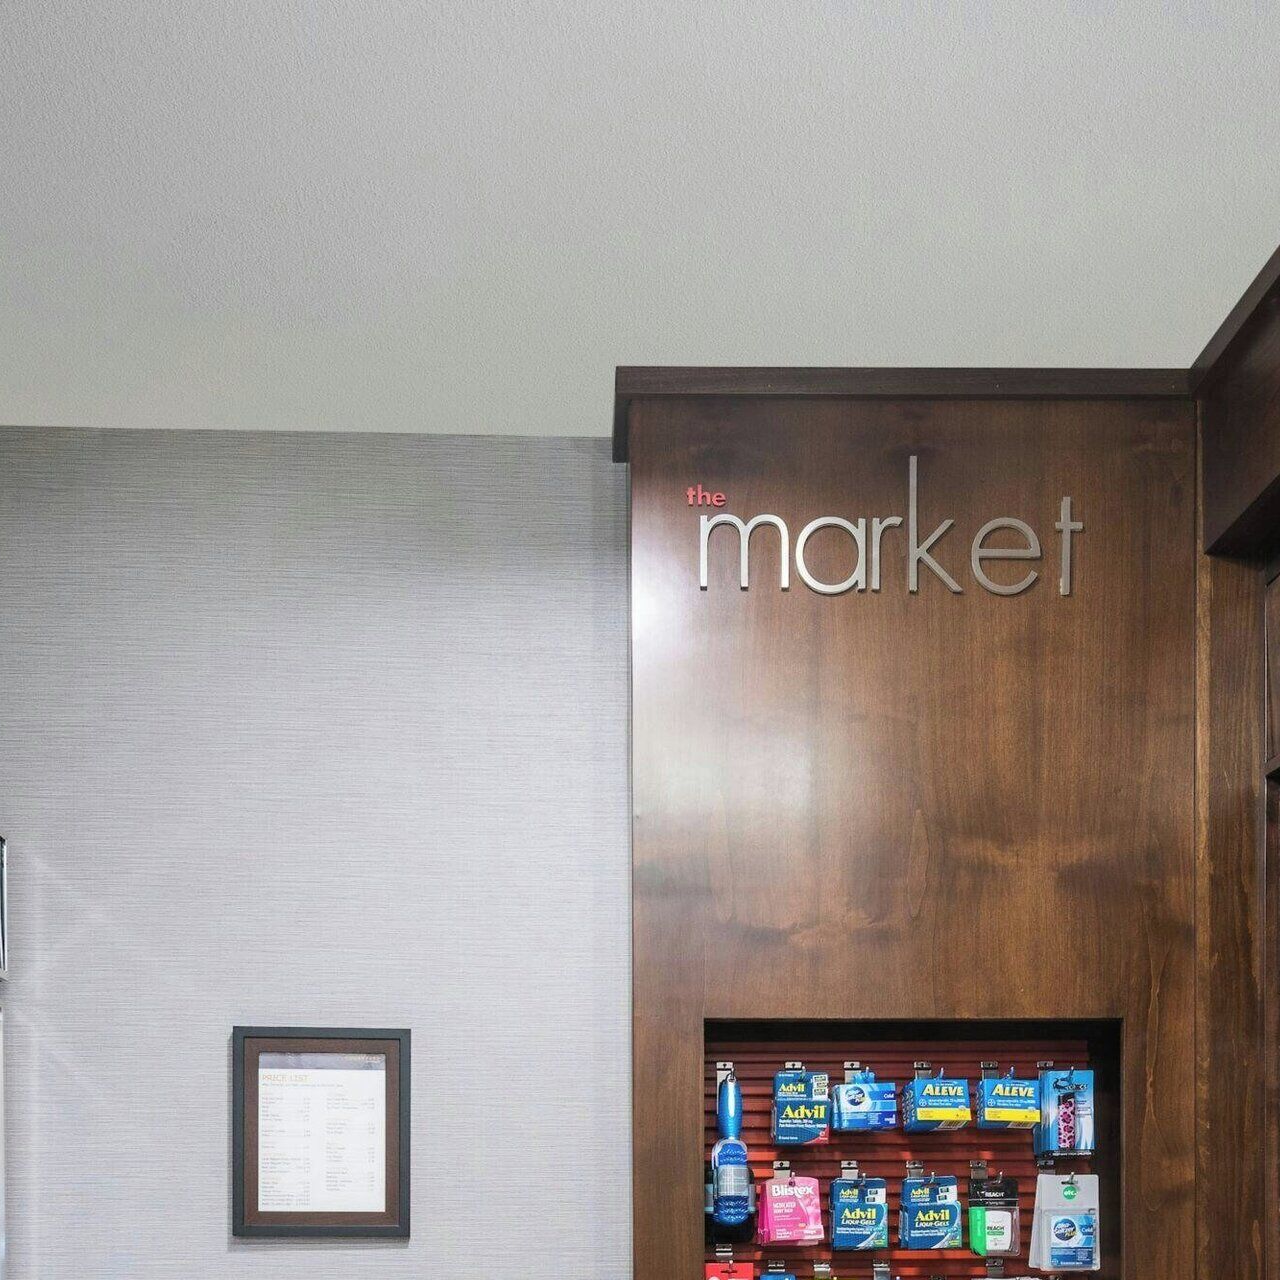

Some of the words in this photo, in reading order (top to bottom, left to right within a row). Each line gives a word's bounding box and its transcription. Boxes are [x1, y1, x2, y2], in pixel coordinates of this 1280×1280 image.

[687, 484, 727, 507] the
[700, 455, 1084, 596] market
[779, 1083, 806, 1092] Advil
[922, 1084, 964, 1097] ALEVE
[992, 1084, 1035, 1098] ALEVE
[782, 1105, 826, 1119] Advil
[771, 1184, 814, 1199] Blistex
[840, 1188, 859, 1197] Advil
[910, 1187, 930, 1197] Advil
[841, 1208, 876, 1219] Advil
[914, 1209, 951, 1222] Advil
